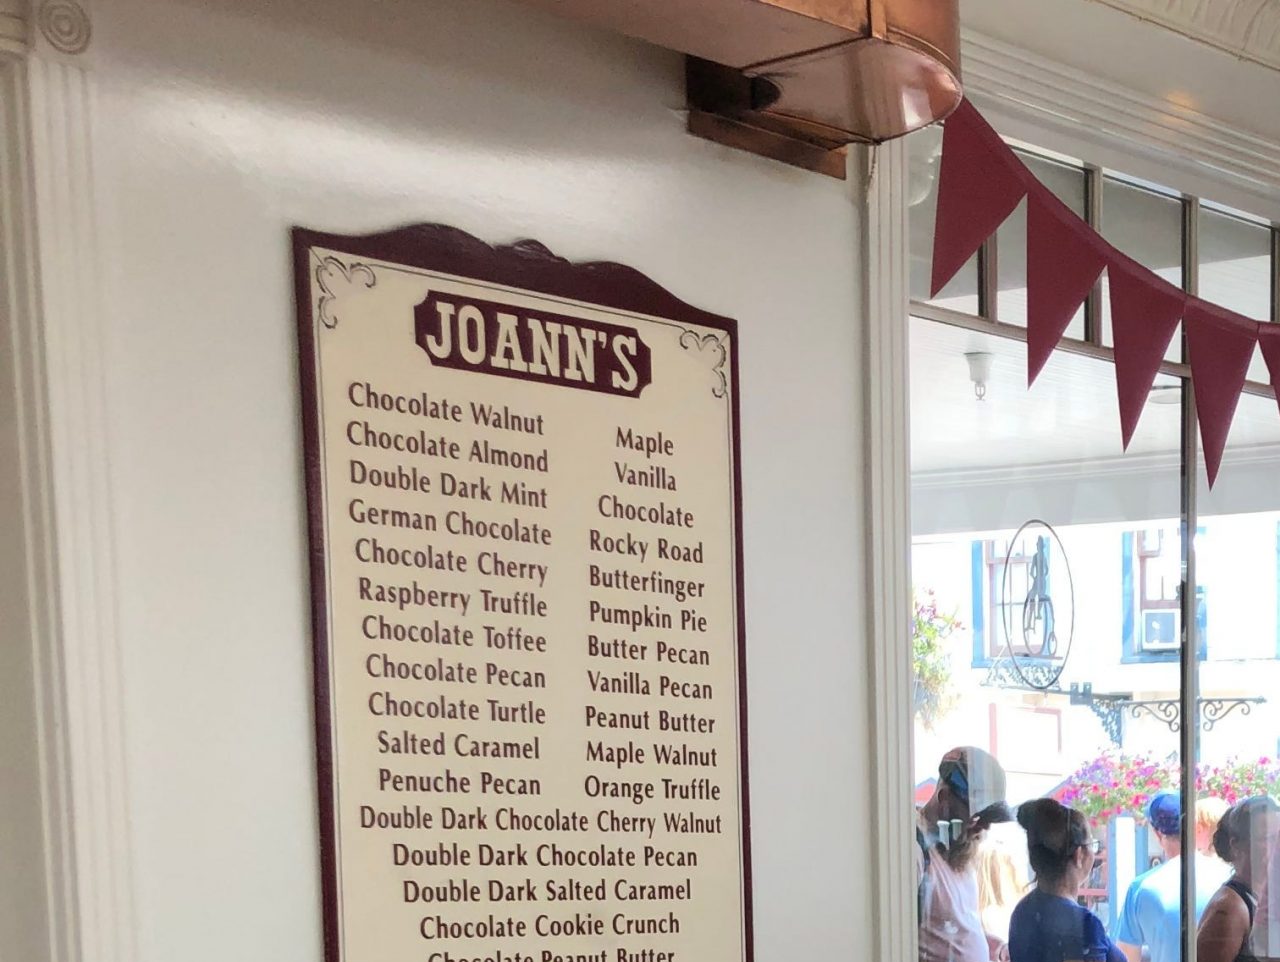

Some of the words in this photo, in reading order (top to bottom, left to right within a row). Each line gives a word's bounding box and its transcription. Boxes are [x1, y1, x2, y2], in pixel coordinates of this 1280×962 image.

[425, 301, 638, 392] JOANN'S
[348, 382, 463, 423] Chocolate
[469, 402, 544, 435] Walnut
[346, 420, 460, 460] Chocolate
[469, 440, 548, 473] Almond
[616, 426, 674, 459] Maple
[350, 459, 431, 493] Double
[440, 472, 492, 501] Dark
[501, 481, 547, 509] Mint
[614, 461, 677, 491] Vanilla
[349, 498, 437, 532] German
[445, 510, 551, 545] Chocolate
[598, 494, 694, 528] Chocolate
[355, 538, 467, 573] Chocolate
[477, 552, 548, 588] Cherry
[590, 529, 649, 563] Rocky
[657, 538, 704, 564] Road
[359, 577, 471, 616] Raspberry
[479, 589, 547, 617] Truffle
[589, 564, 705, 603] Butterfinger
[589, 600, 672, 632] Pumpkin
[680, 609, 707, 632] Pie
[362, 614, 474, 647] Chocolate
[482, 625, 546, 653] Toffee
[588, 635, 648, 661] Butter
[656, 641, 710, 666] Pecan
[366, 653, 478, 684] Chocolate
[486, 662, 546, 688] Pecan
[587, 670, 651, 695] Vanilla
[659, 675, 713, 700] Pecan
[368, 691, 479, 721] Chocolate
[486, 699, 546, 725] Turtle
[585, 705, 650, 730] Peanut
[658, 710, 716, 734] Butter
[377, 730, 446, 756] Salted
[454, 733, 540, 760] Caramel
[586, 740, 645, 770] Maple
[653, 744, 717, 767] Walnut
[379, 768, 471, 794] Penuche
[480, 772, 541, 796] Pecan
[584, 775, 655, 805] Orange
[661, 778, 720, 801] Truffle
[360, 805, 433, 830] Double
[441, 806, 488, 830] Dark
[495, 807, 589, 832] Chocolate
[597, 809, 656, 840] Cherry
[663, 811, 722, 834] Walnut
[392, 842, 471, 867] Double
[478, 843, 528, 867] Dark
[536, 843, 636, 867] Chocolate
[643, 845, 697, 867] Pecan
[403, 878, 481, 903] Double
[488, 878, 538, 902] Dark
[546, 878, 607, 902] Salted
[614, 878, 691, 901] Caramel
[420, 914, 527, 940] Chocolate
[535, 913, 604, 937] Cookie
[612, 911, 679, 935] Crunch
